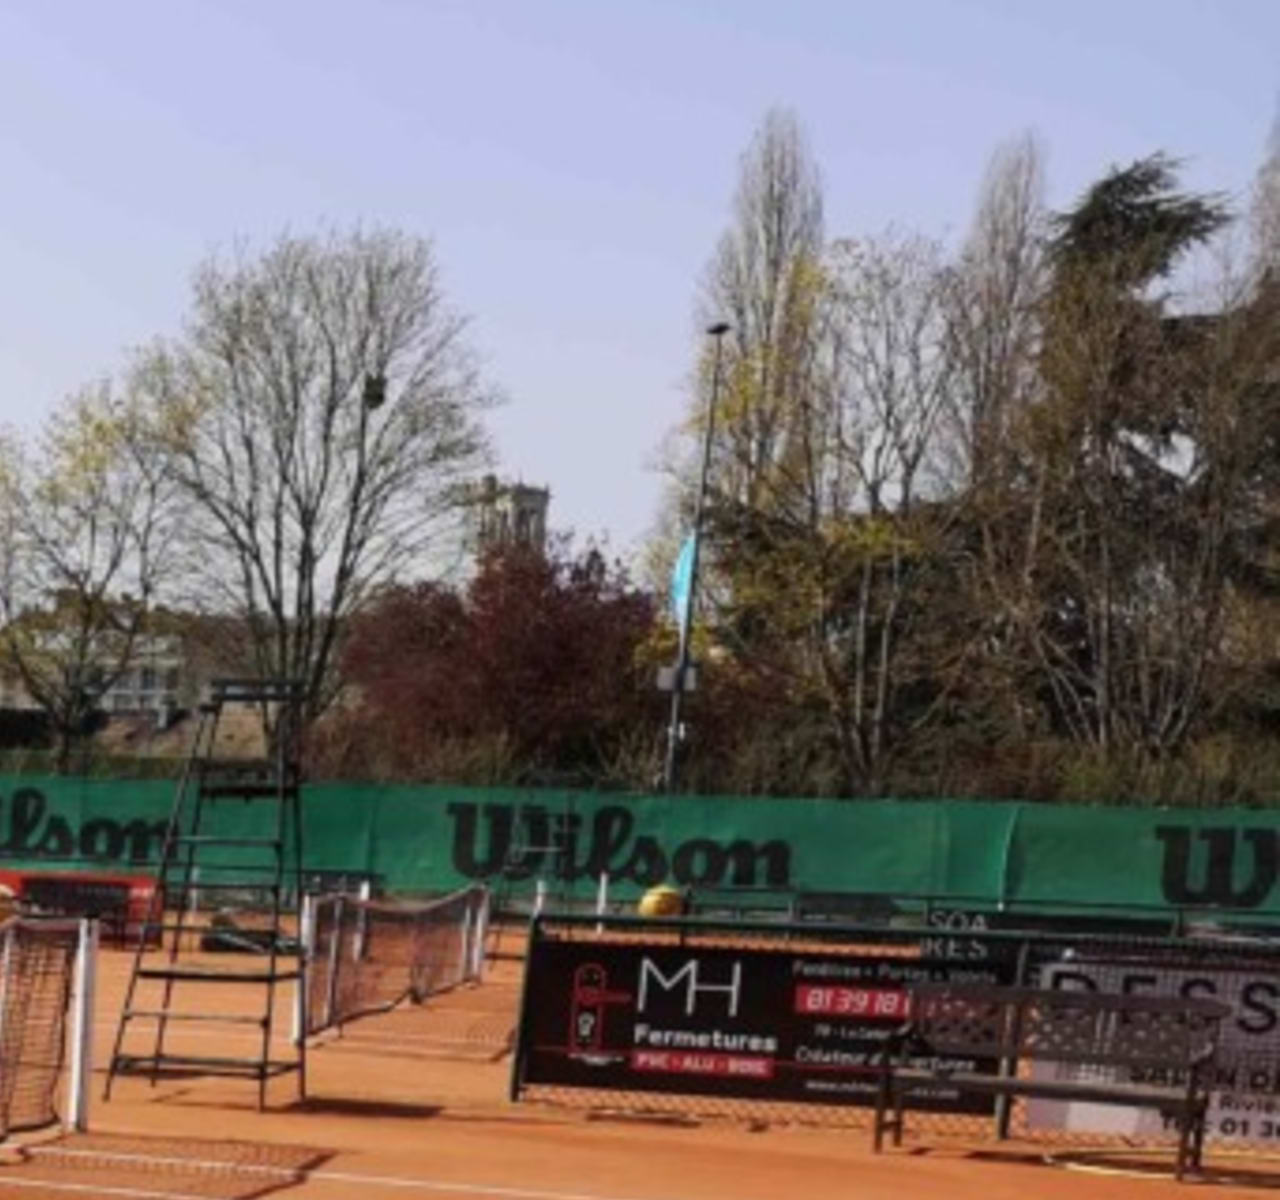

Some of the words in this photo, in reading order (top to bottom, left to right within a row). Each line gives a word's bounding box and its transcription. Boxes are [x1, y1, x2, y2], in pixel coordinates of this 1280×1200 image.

[446, 801, 792, 887] Wilson
[637, 956, 741, 1017] MH
[634, 1023, 778, 1052] Fermetures
